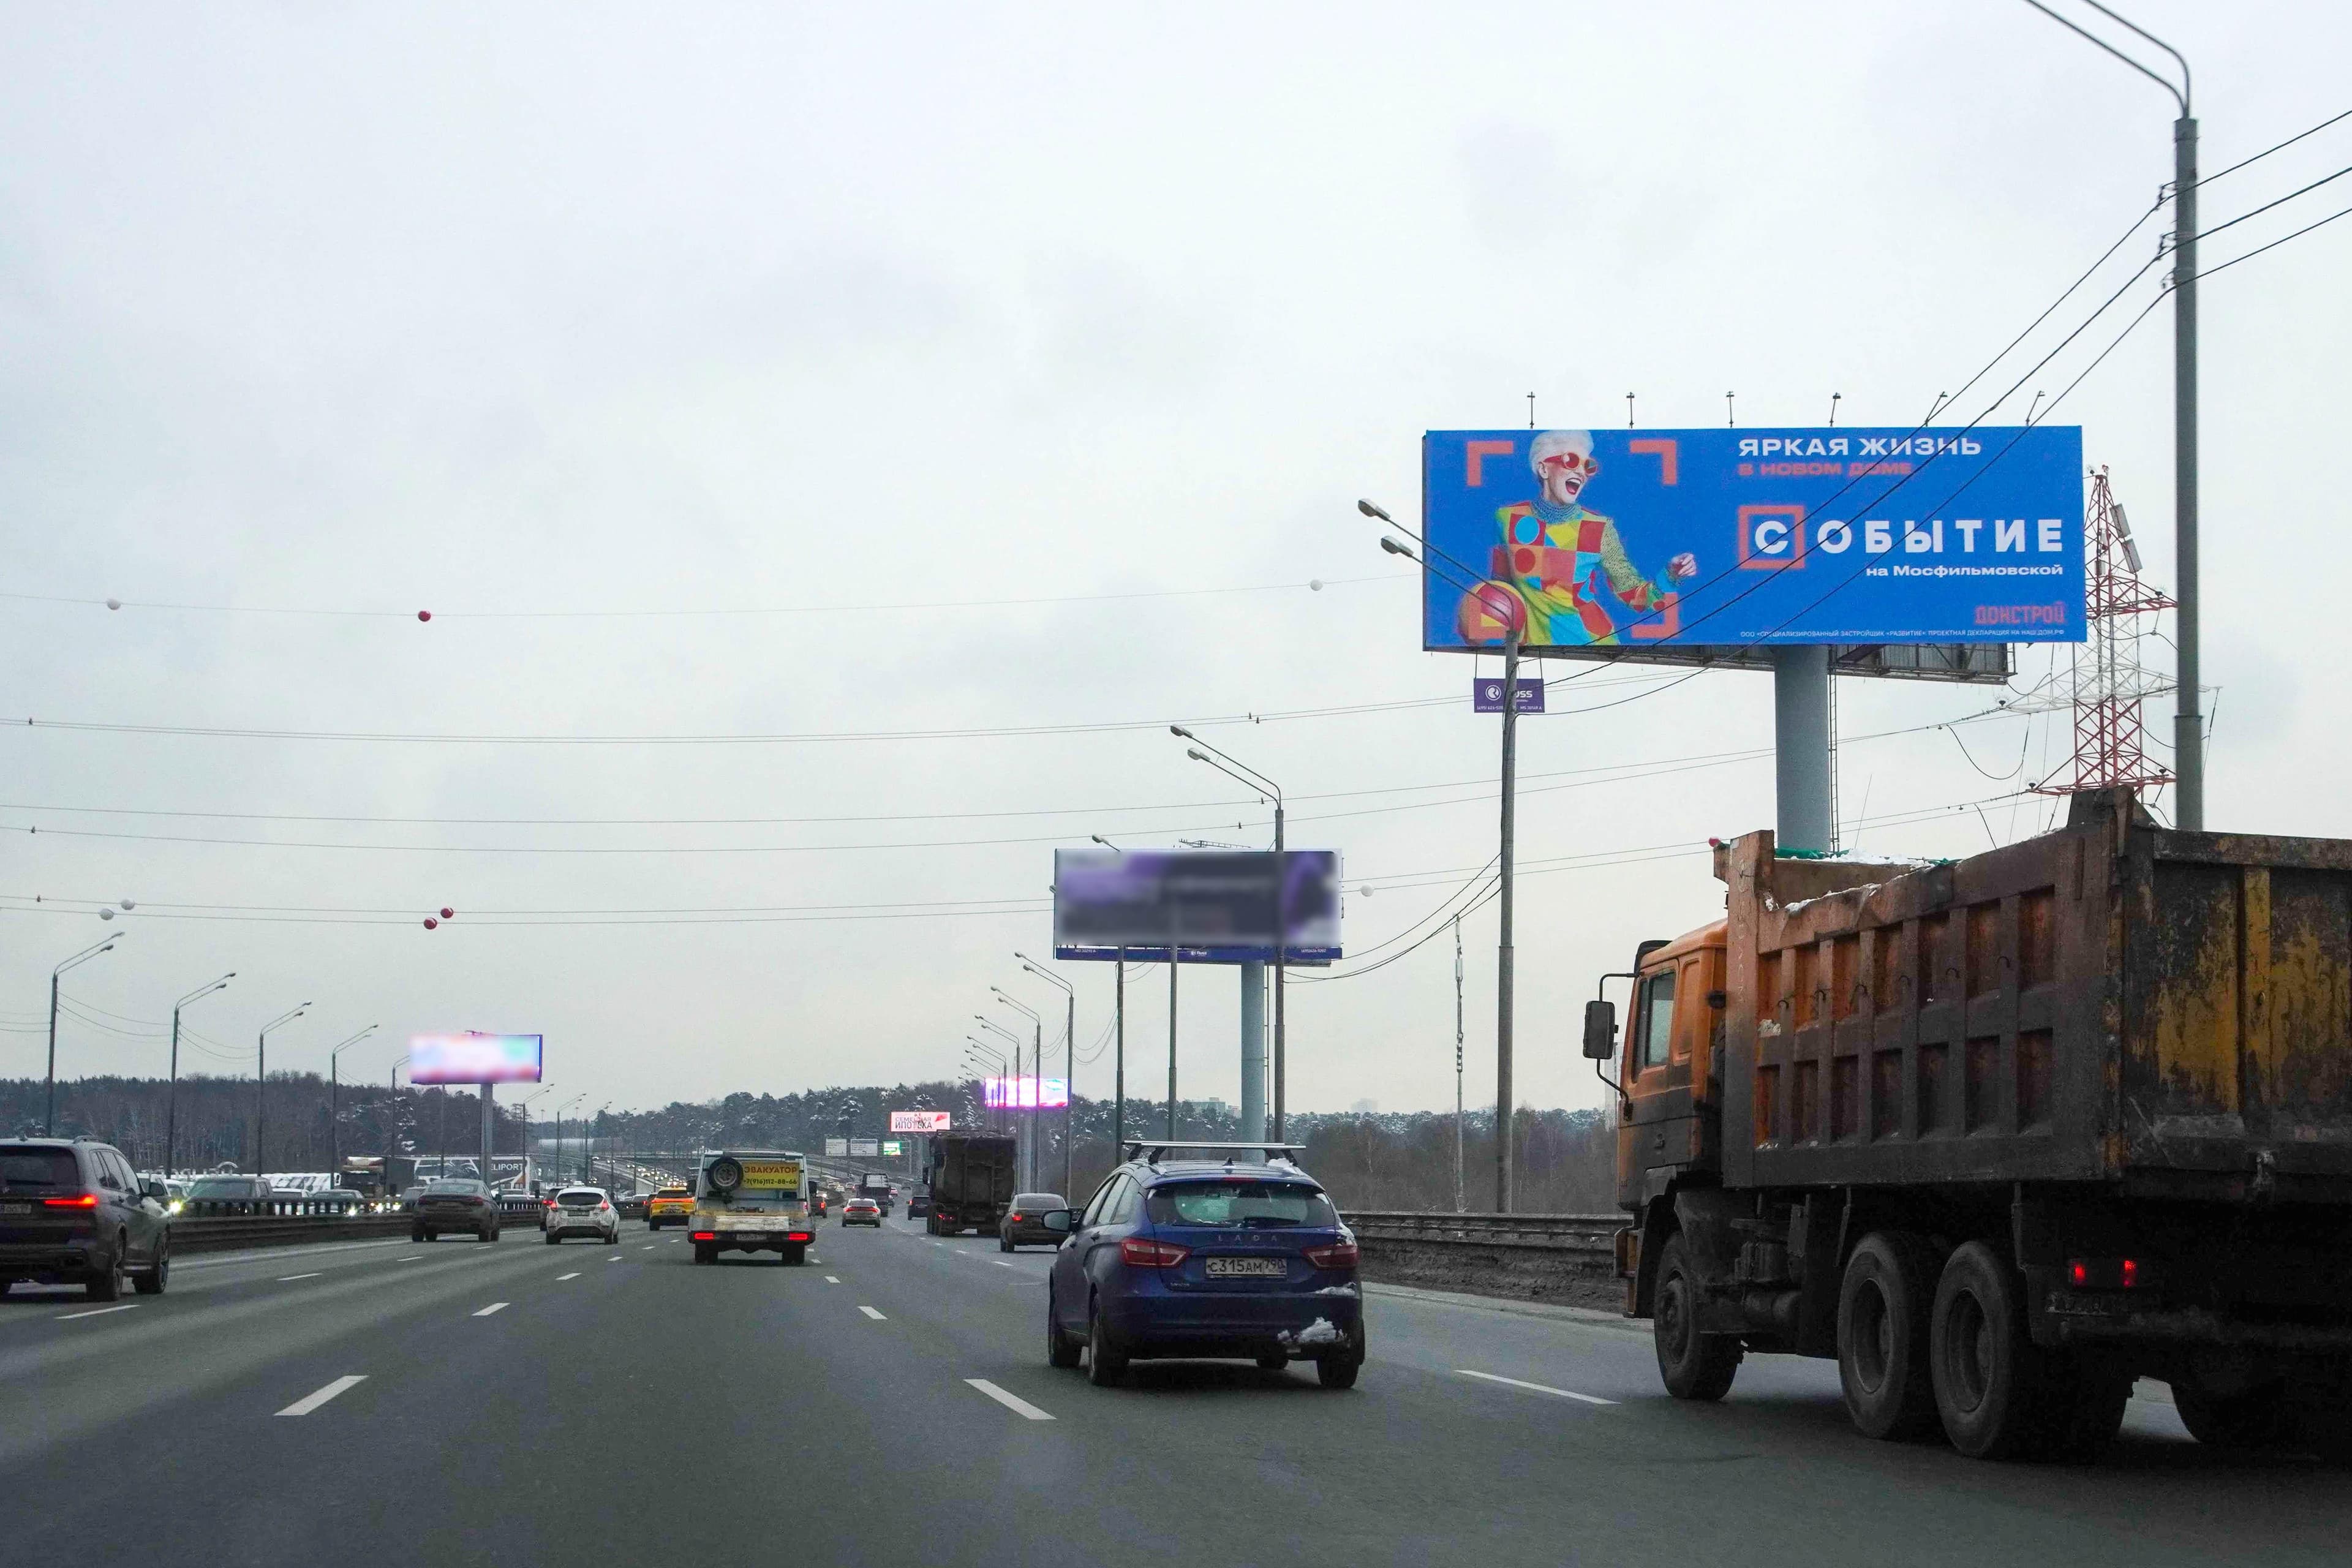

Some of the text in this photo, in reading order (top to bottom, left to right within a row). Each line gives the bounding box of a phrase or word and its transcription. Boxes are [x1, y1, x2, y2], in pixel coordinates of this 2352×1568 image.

[1738, 437, 1981, 456] ЯРКАЯ ЖИЗНЬ
[1738, 462, 1913, 477] В НОВОМ ДОМЕ
[1754, 519, 2063, 554] СОБЫТИЕ
[1866, 564, 2064, 578] на Мосфильмовской
[1974, 601, 2065, 625] ДОНСТРОЙ
